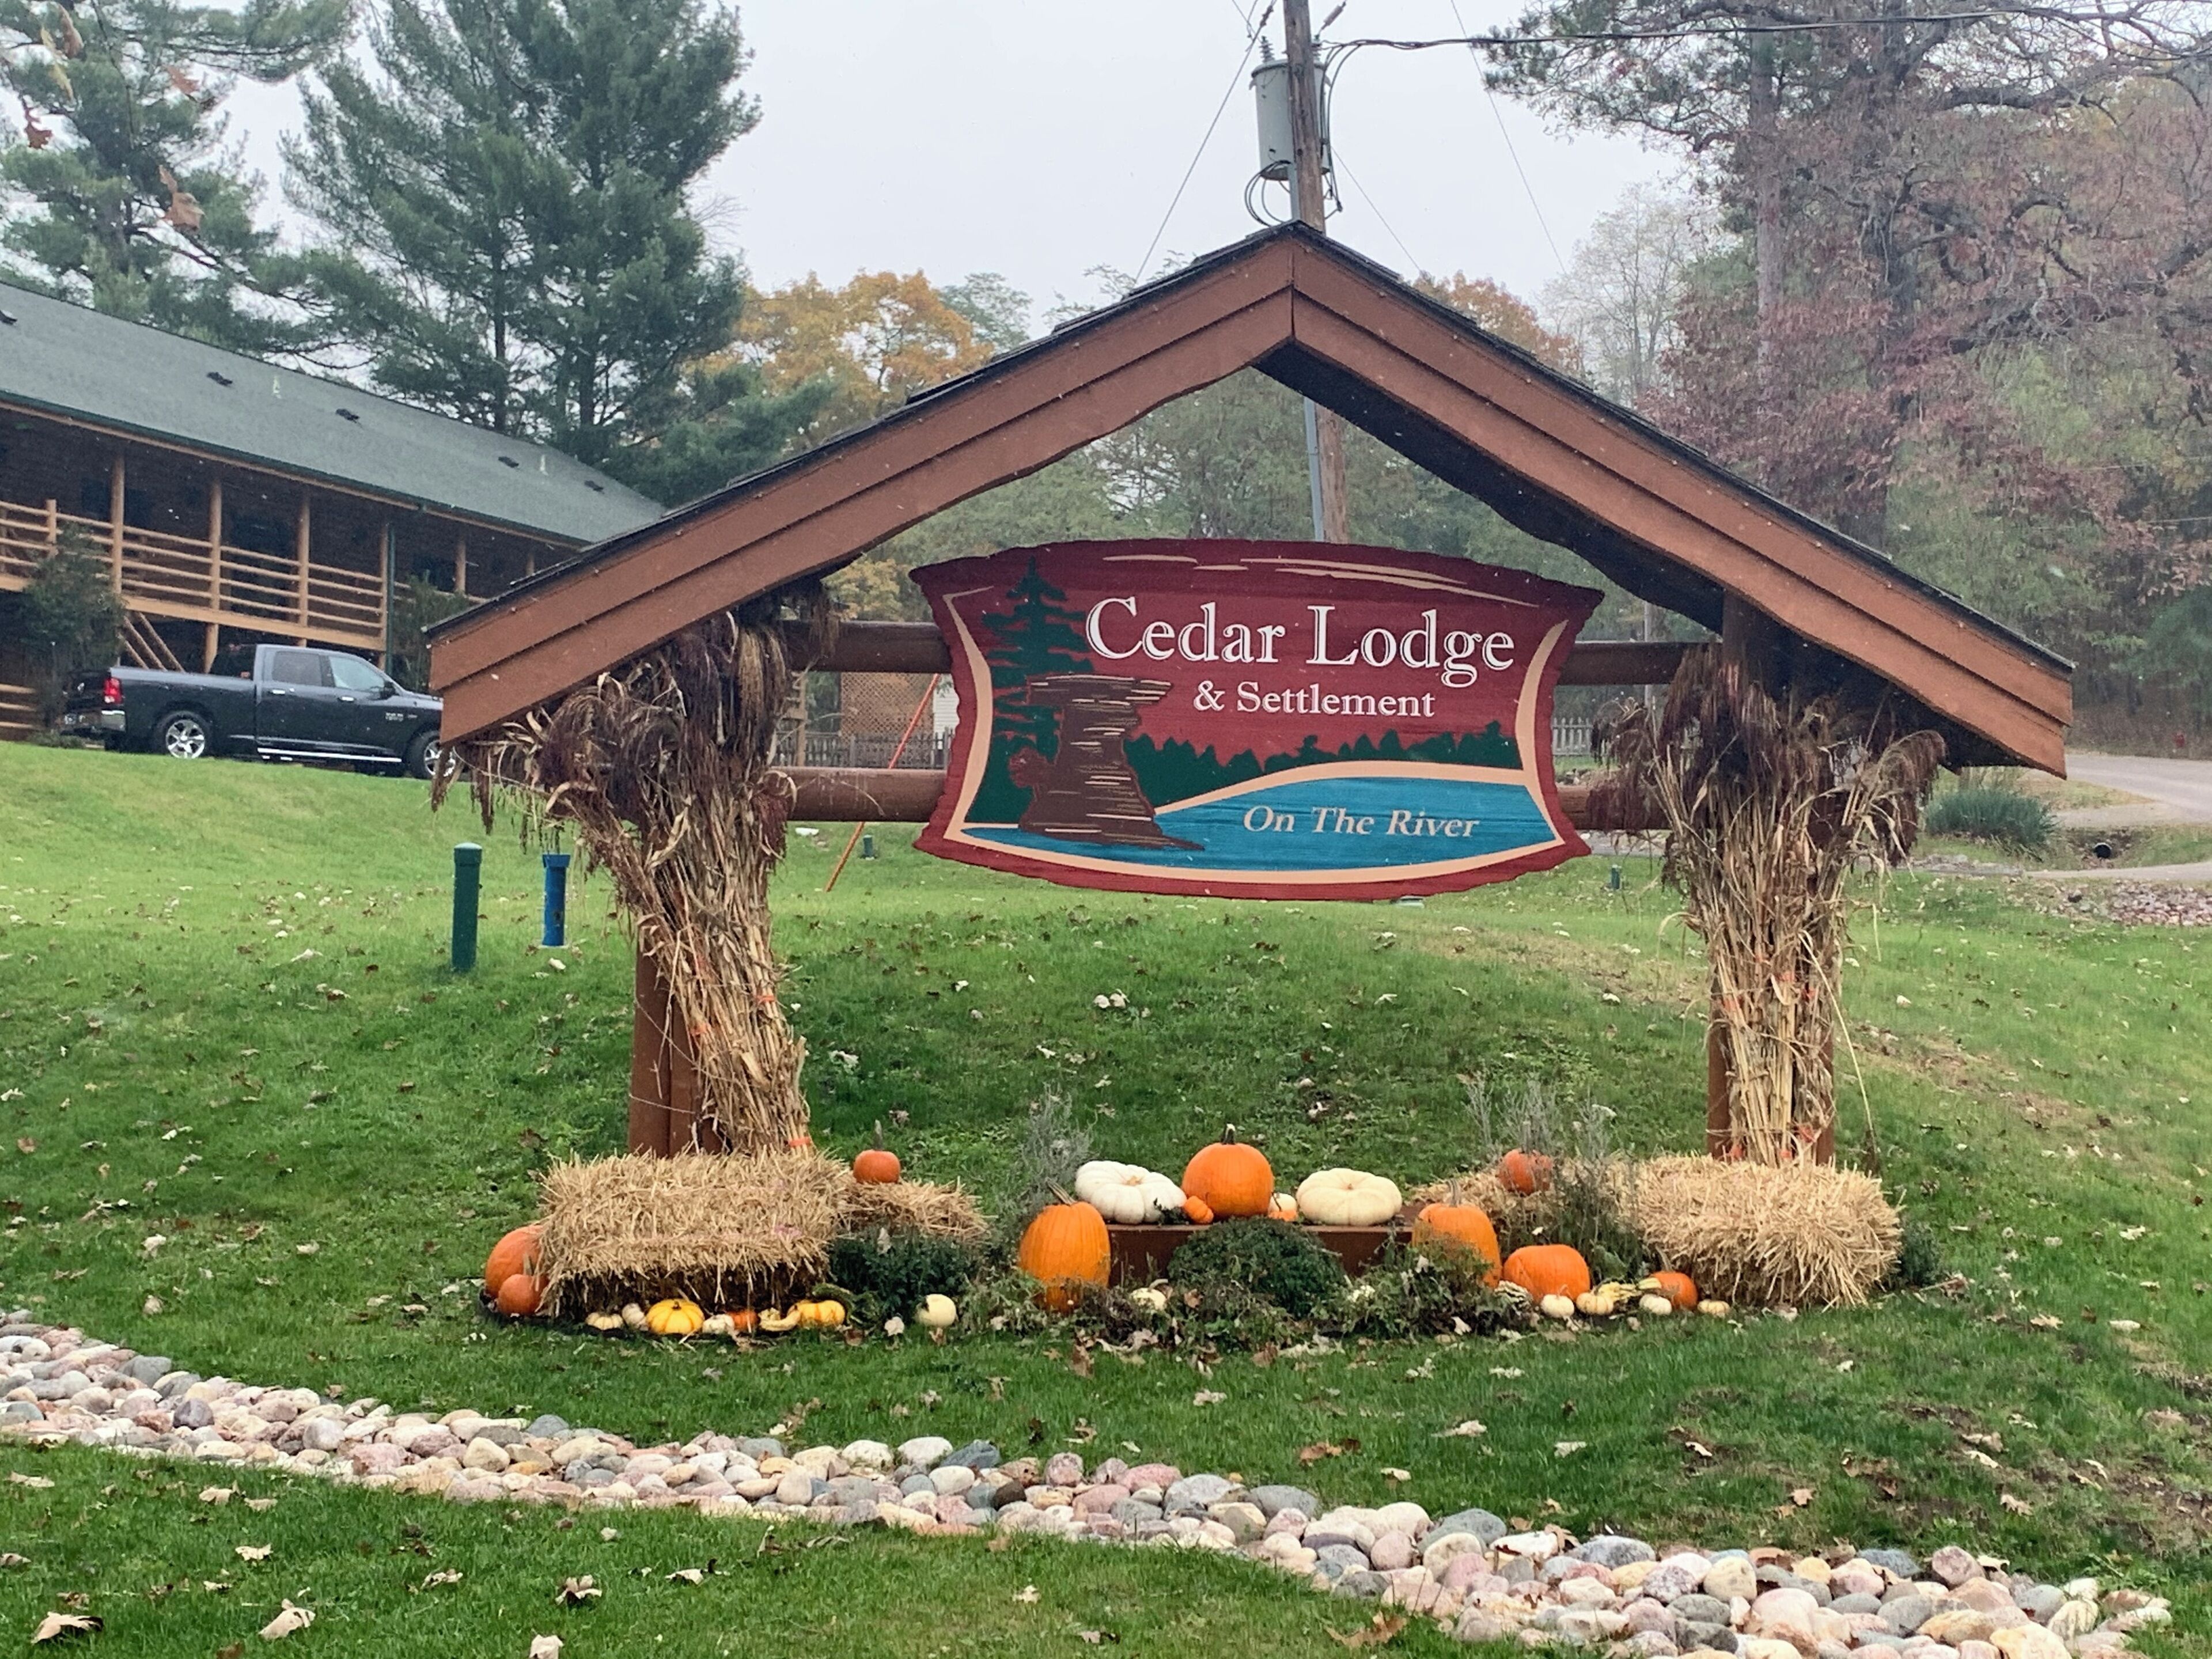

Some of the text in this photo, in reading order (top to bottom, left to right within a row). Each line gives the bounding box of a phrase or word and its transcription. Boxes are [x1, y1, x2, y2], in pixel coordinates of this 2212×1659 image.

[1085, 596, 1515, 689] Cedar Lodge
[1194, 680, 1436, 718] & Settlement
[1243, 805, 1480, 839] On The River
